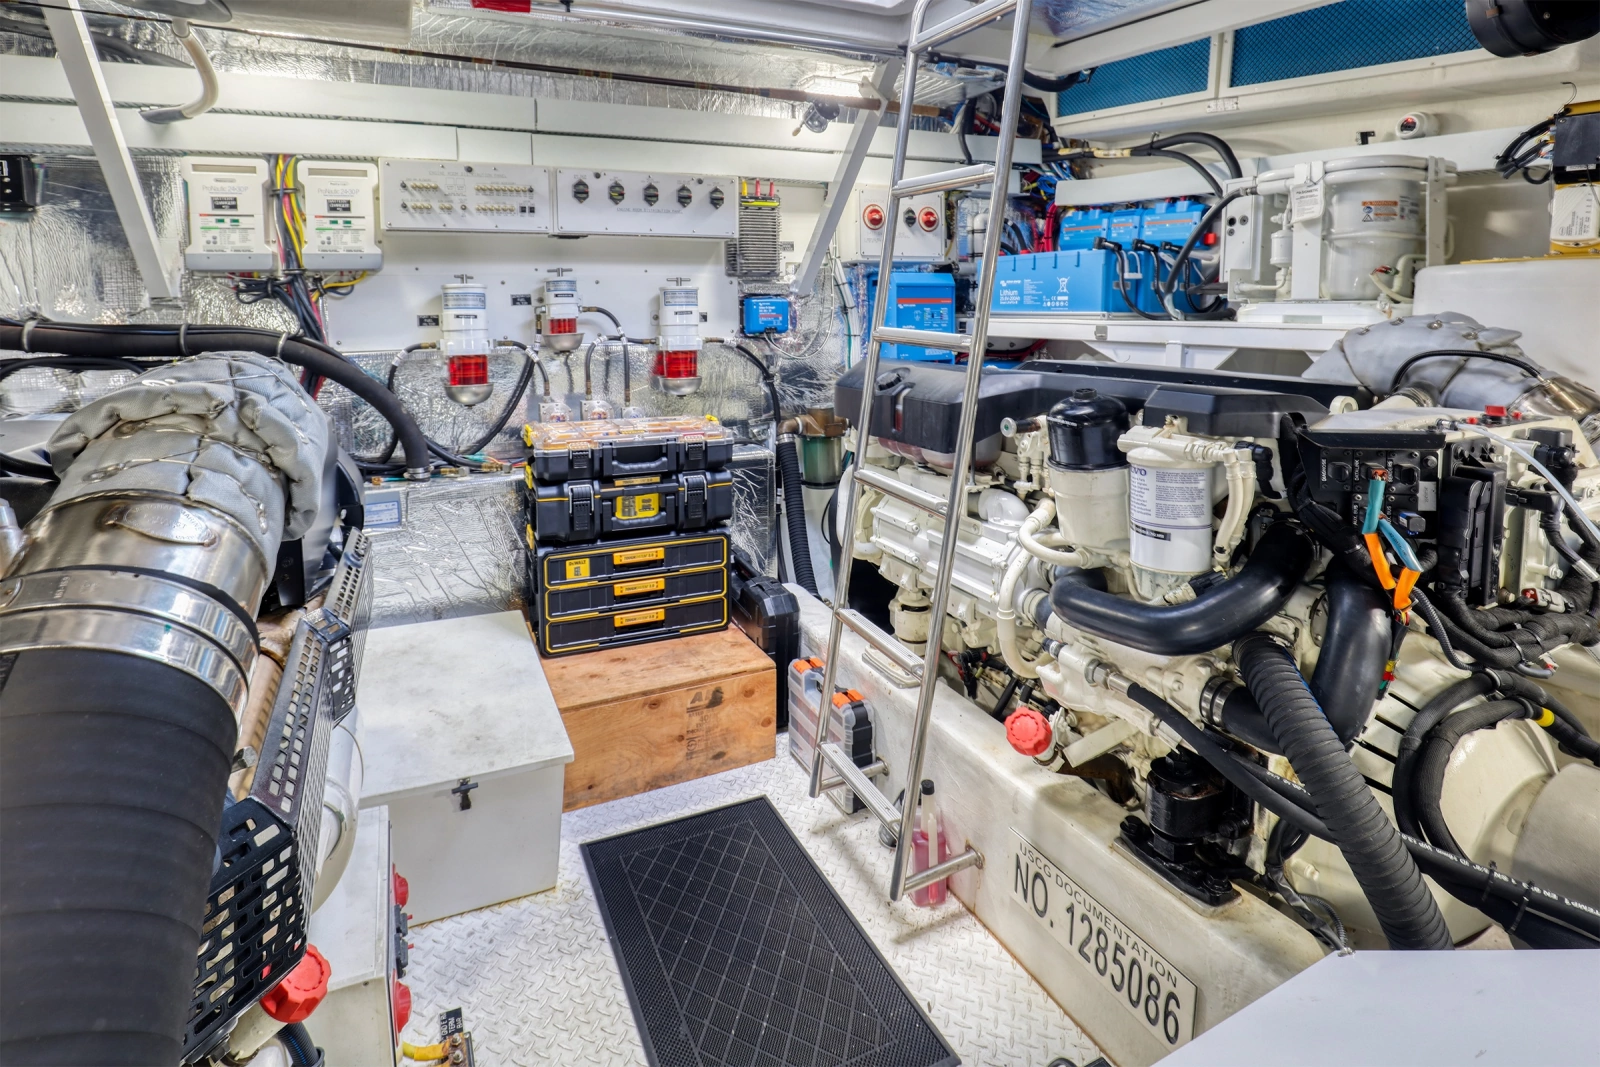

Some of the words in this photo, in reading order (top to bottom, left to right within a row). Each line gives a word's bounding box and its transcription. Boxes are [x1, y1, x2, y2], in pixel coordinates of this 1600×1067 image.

[1014, 853, 1054, 929] NO.
[1066, 902, 1181, 1045] 1285086
[1019, 842, 1052, 878] USCG
[1055, 875, 1178, 988] DOCUMENTATION
